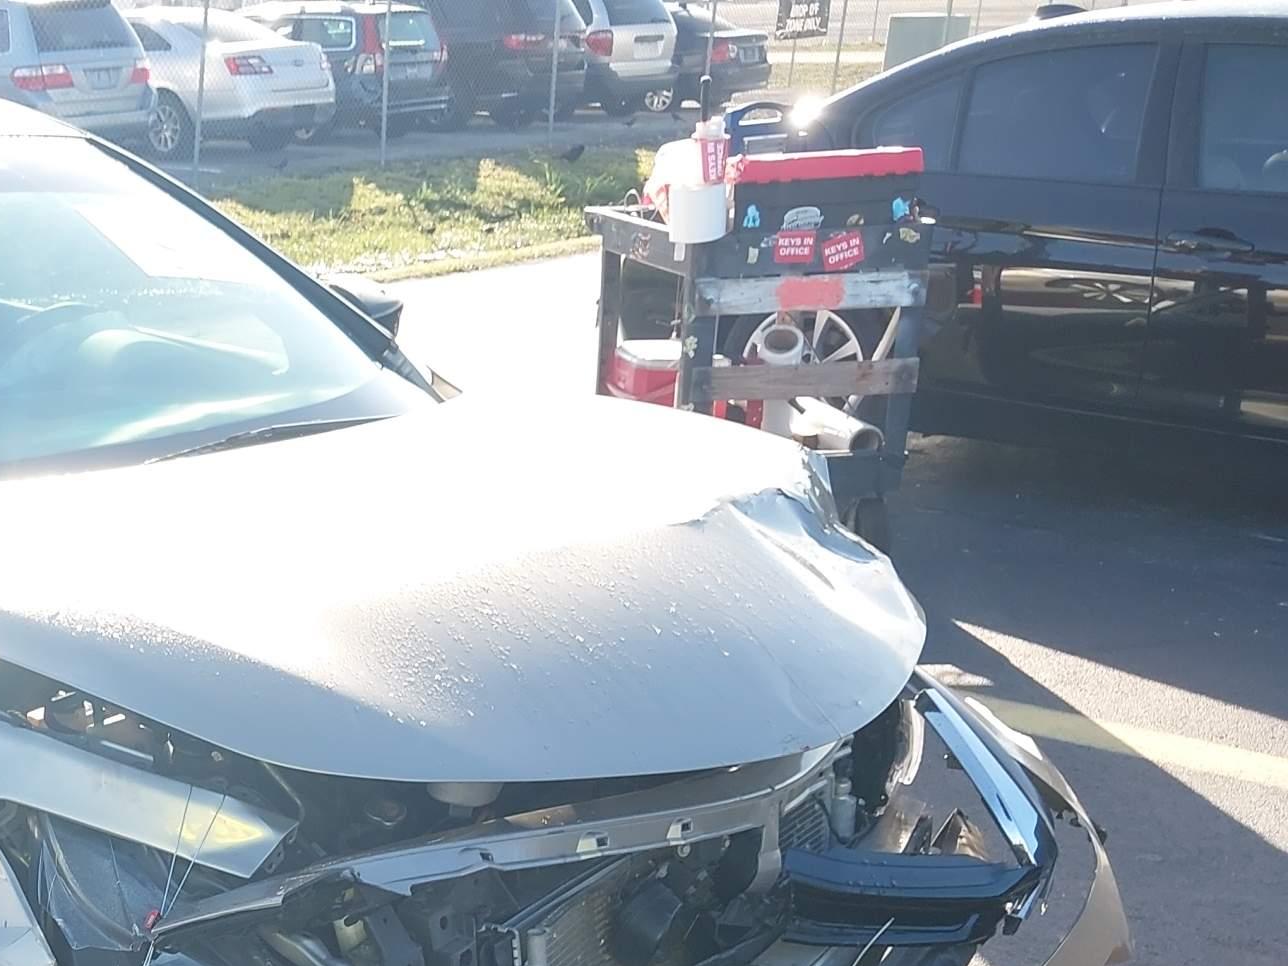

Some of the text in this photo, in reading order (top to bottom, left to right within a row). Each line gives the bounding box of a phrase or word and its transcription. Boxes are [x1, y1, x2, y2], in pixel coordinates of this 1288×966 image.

[778, 237, 813, 246] KEYS IN
[824, 237, 860, 256] KEYS IN
[779, 246, 810, 256] OFFICE
[828, 247, 859, 264] OFFICE
